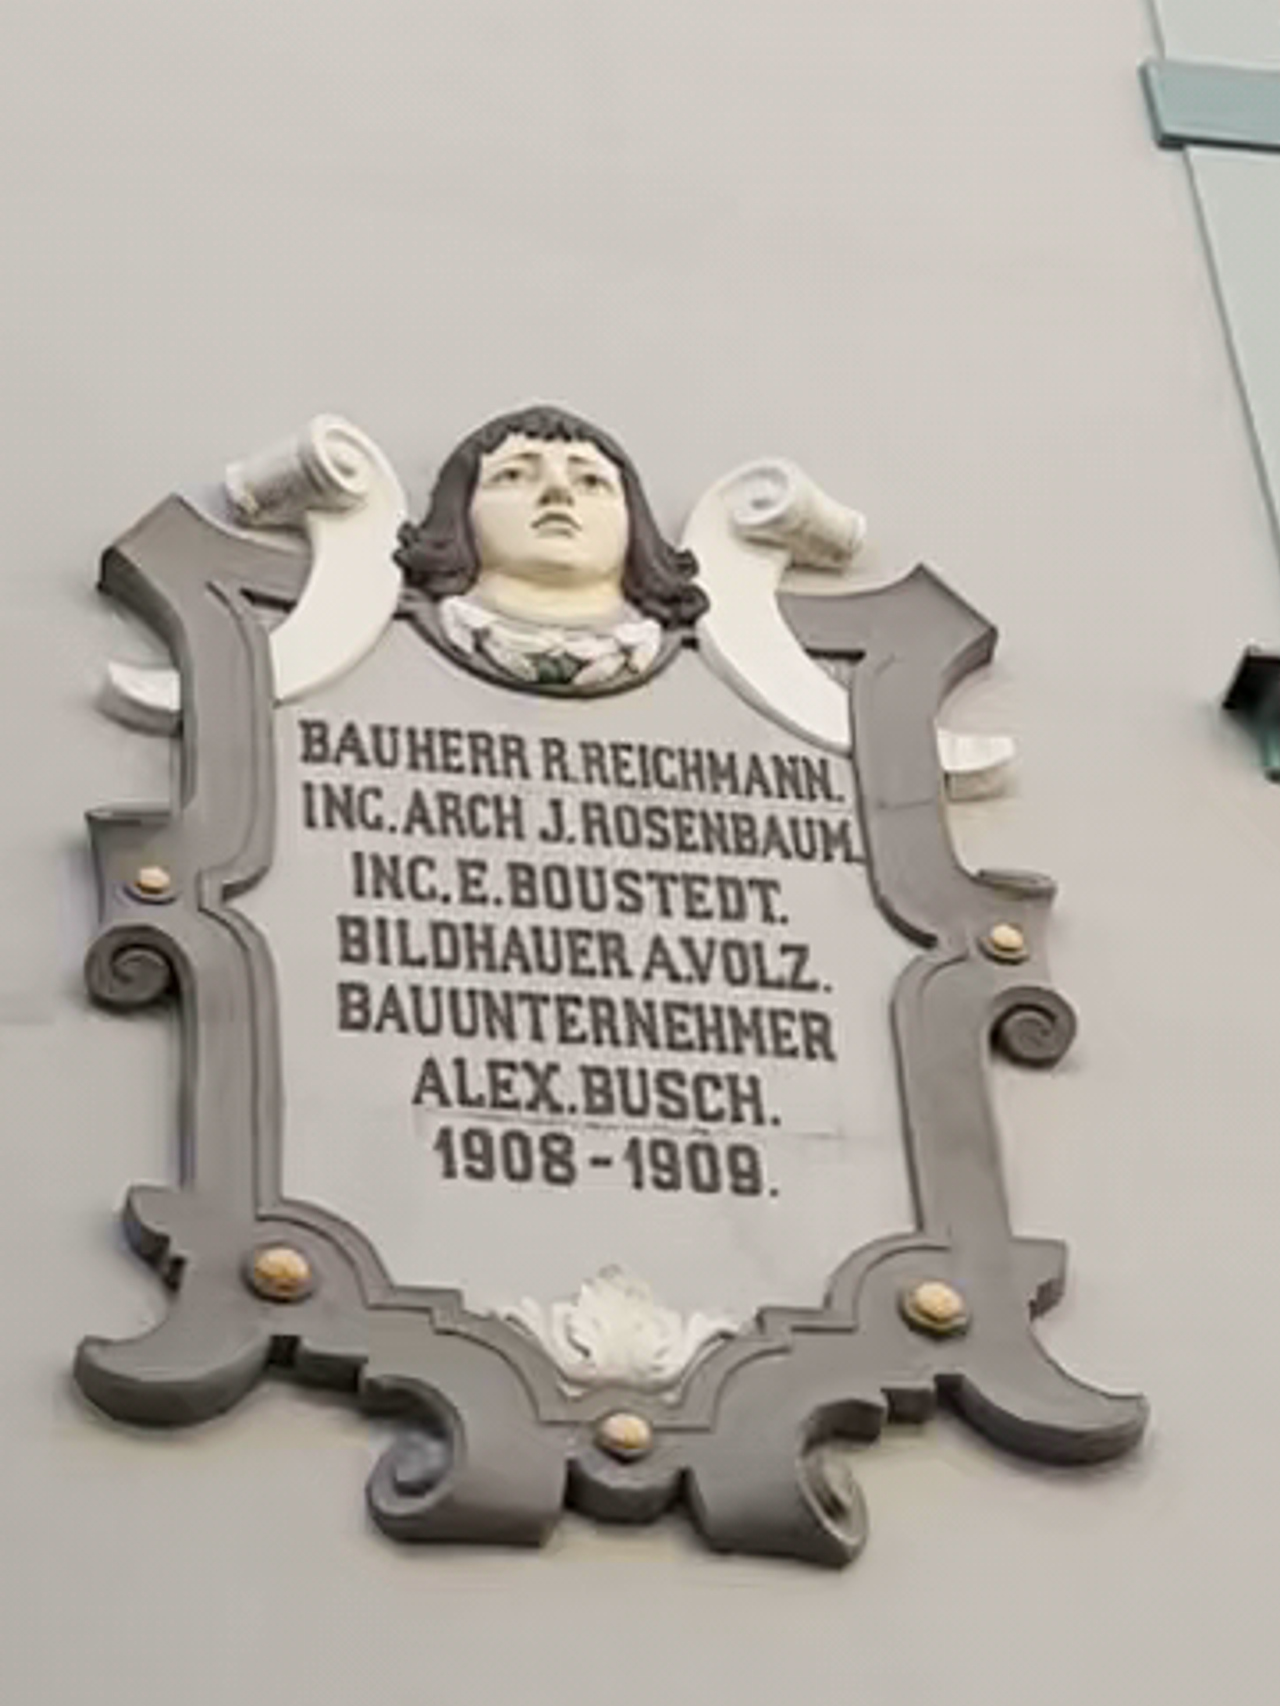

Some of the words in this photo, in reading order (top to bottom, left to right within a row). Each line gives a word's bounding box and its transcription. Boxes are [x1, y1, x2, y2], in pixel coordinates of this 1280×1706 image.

[298, 719, 530, 781] BAUHERR
[337, 915, 634, 978] BILDHAUER
[337, 981, 837, 1062] BAUUNTERNEHMER
